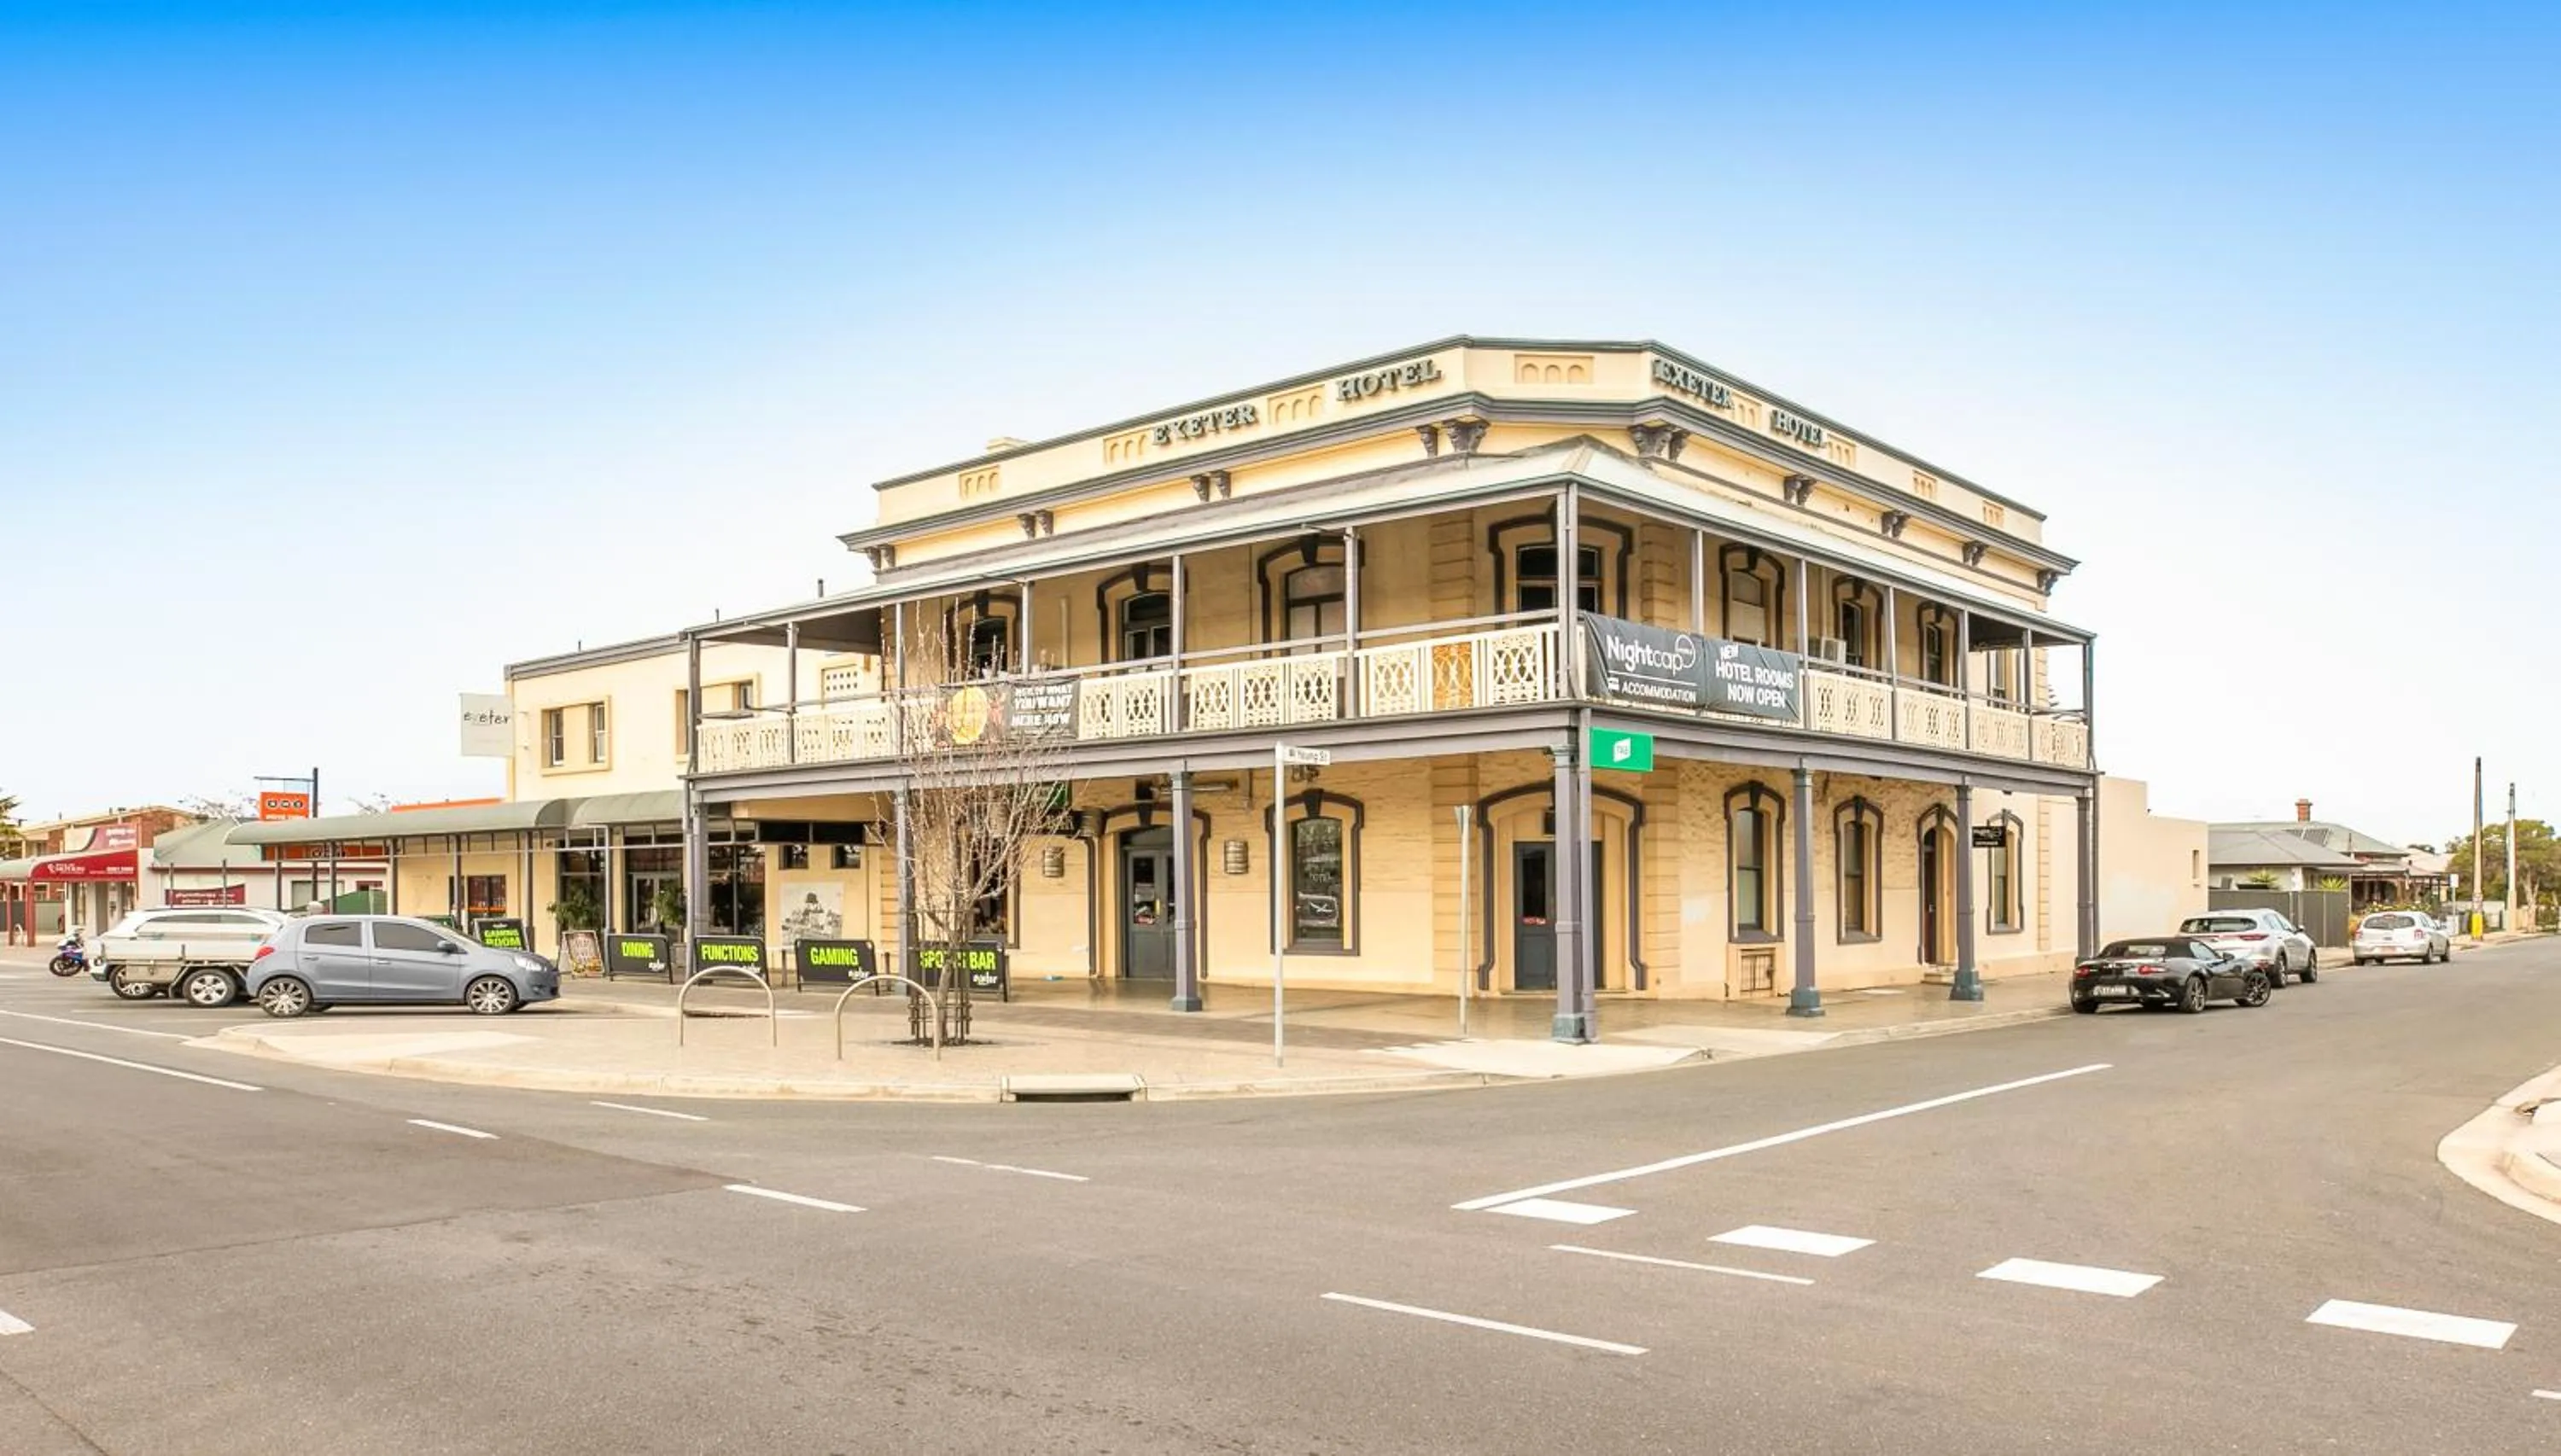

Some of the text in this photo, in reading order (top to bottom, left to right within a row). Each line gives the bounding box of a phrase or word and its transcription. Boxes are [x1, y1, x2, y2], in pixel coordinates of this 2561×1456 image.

[1152, 358, 1443, 446] EXETER HOTEL
[1652, 358, 1828, 450] EXETER HOTEL
[1606, 634, 1684, 676] Nightcap
[1720, 644, 1739, 661] NEW
[1715, 660, 1794, 690] HOTEL ROOMS
[1621, 679, 1697, 703] ACCOMMODATION
[1727, 683, 1787, 709] NOW OPEN
[1036, 695, 1073, 709] WANT
[484, 929, 519, 938] GAMING
[484, 937, 522, 948] ROOM
[621, 941, 655, 958] DINING
[700, 944, 759, 962] FUNCTIONS
[810, 946, 860, 966] GAMING
[919, 949, 996, 970] SPOS BAR
